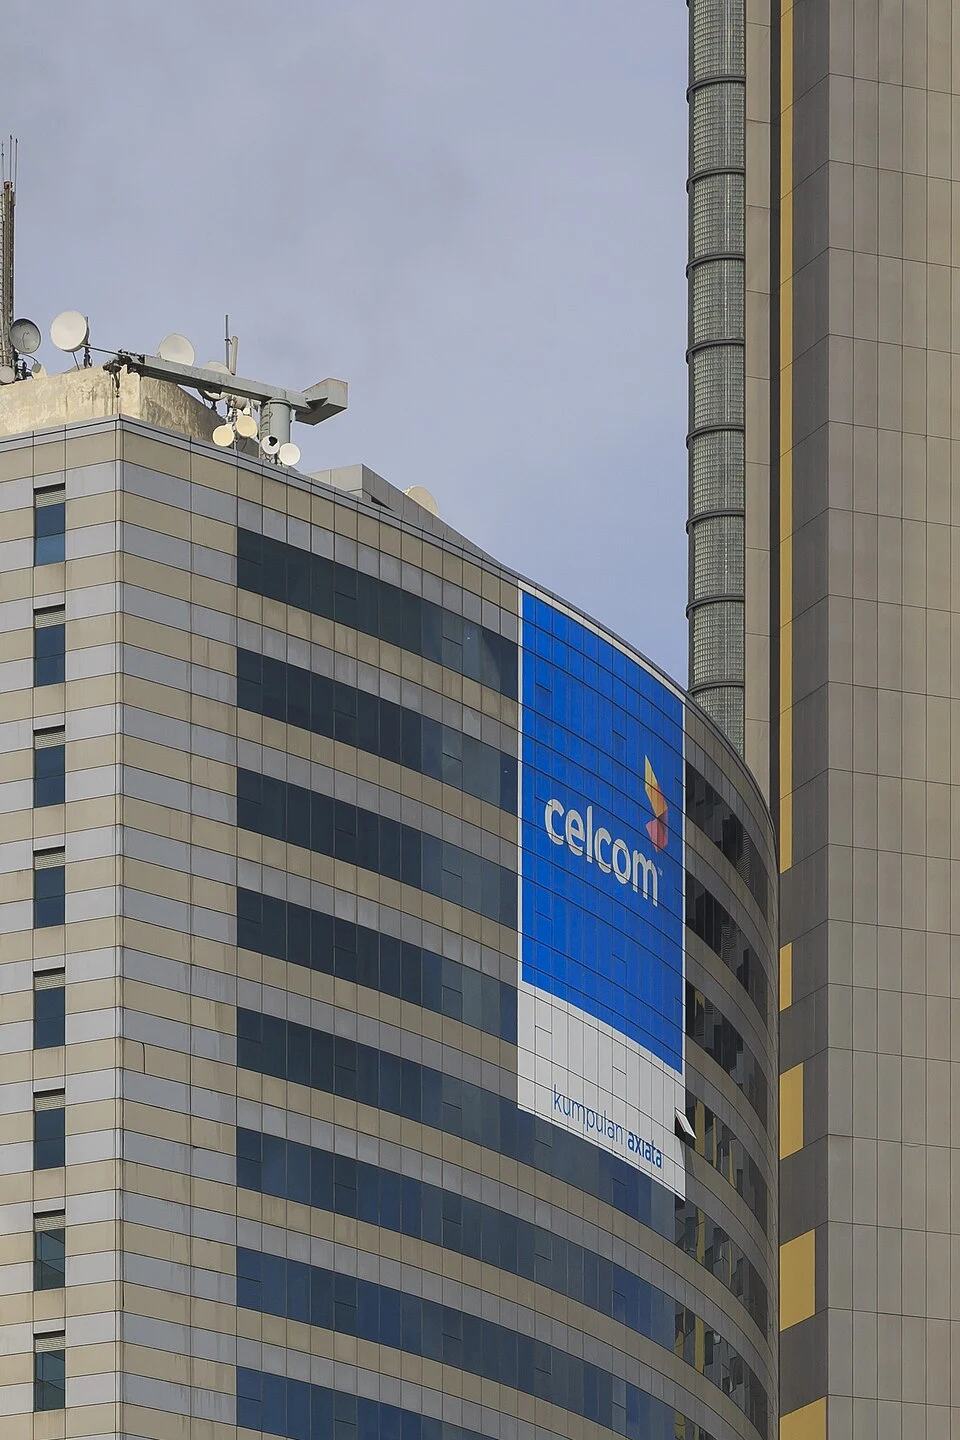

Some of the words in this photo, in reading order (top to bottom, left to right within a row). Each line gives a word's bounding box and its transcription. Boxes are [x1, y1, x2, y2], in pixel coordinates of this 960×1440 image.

[544, 798, 658, 907] celcom
[553, 1084, 623, 1145] kumpulan
[627, 1131, 662, 1169] axiata
